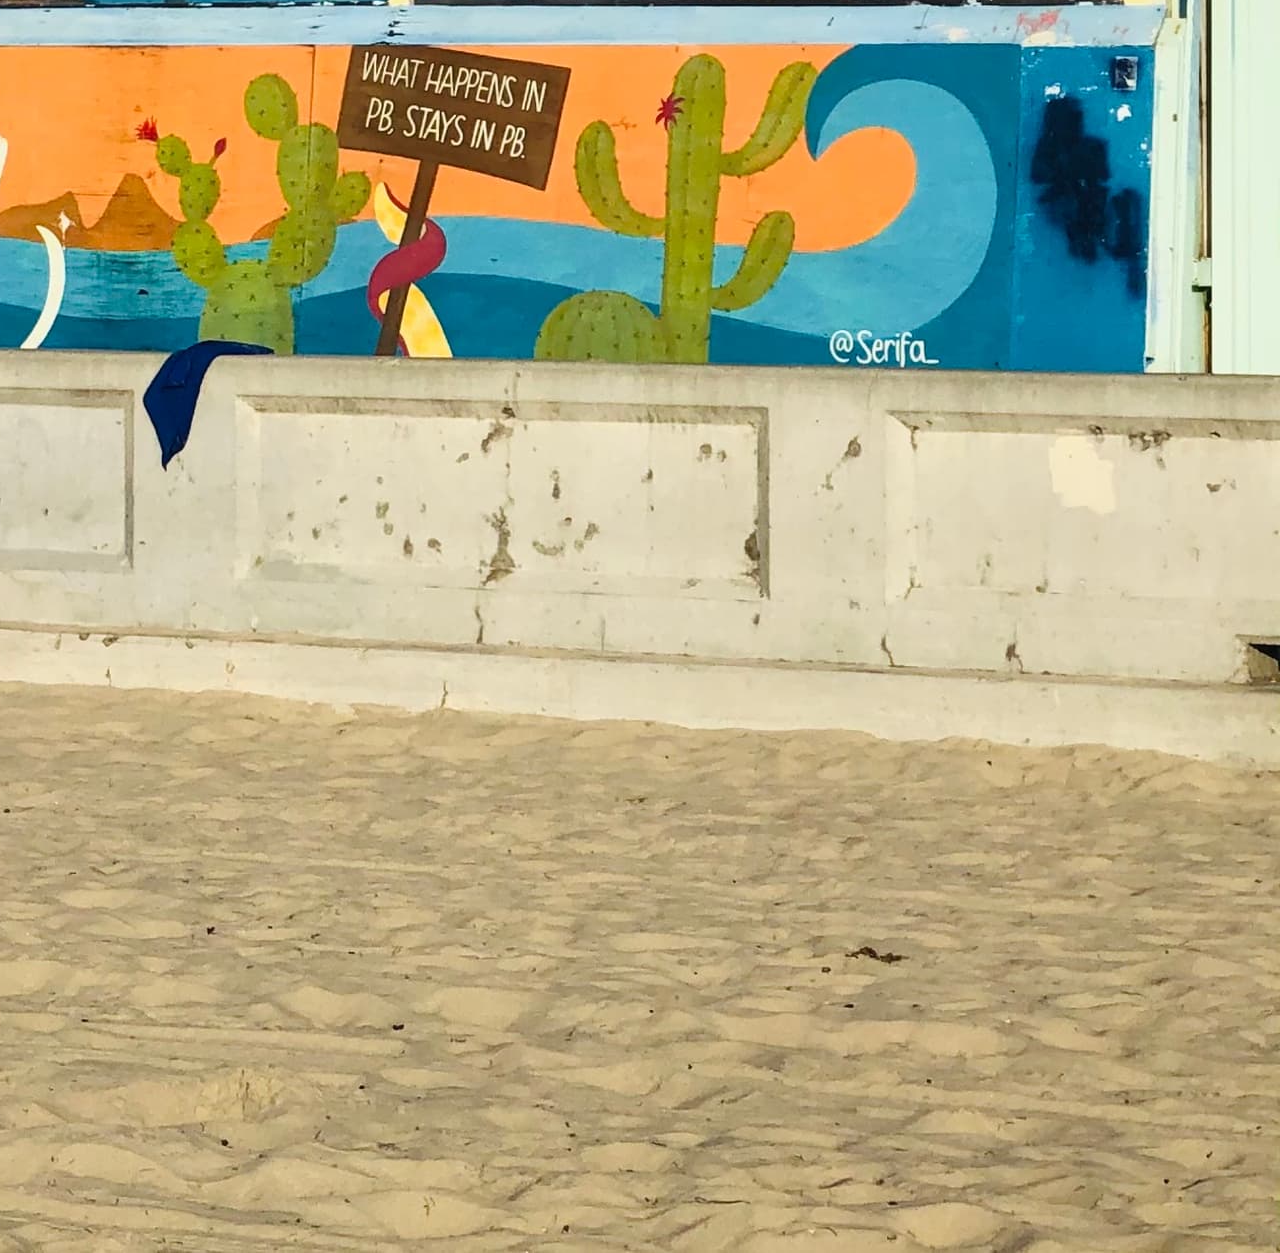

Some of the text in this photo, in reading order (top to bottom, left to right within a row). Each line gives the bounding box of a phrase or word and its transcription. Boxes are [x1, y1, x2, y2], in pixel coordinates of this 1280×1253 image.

[361, 51, 547, 113] WHAT HAPPENS IN
[365, 96, 526, 160] PB, STAYS IN PB.
[829, 330, 940, 368] @Serifa_
